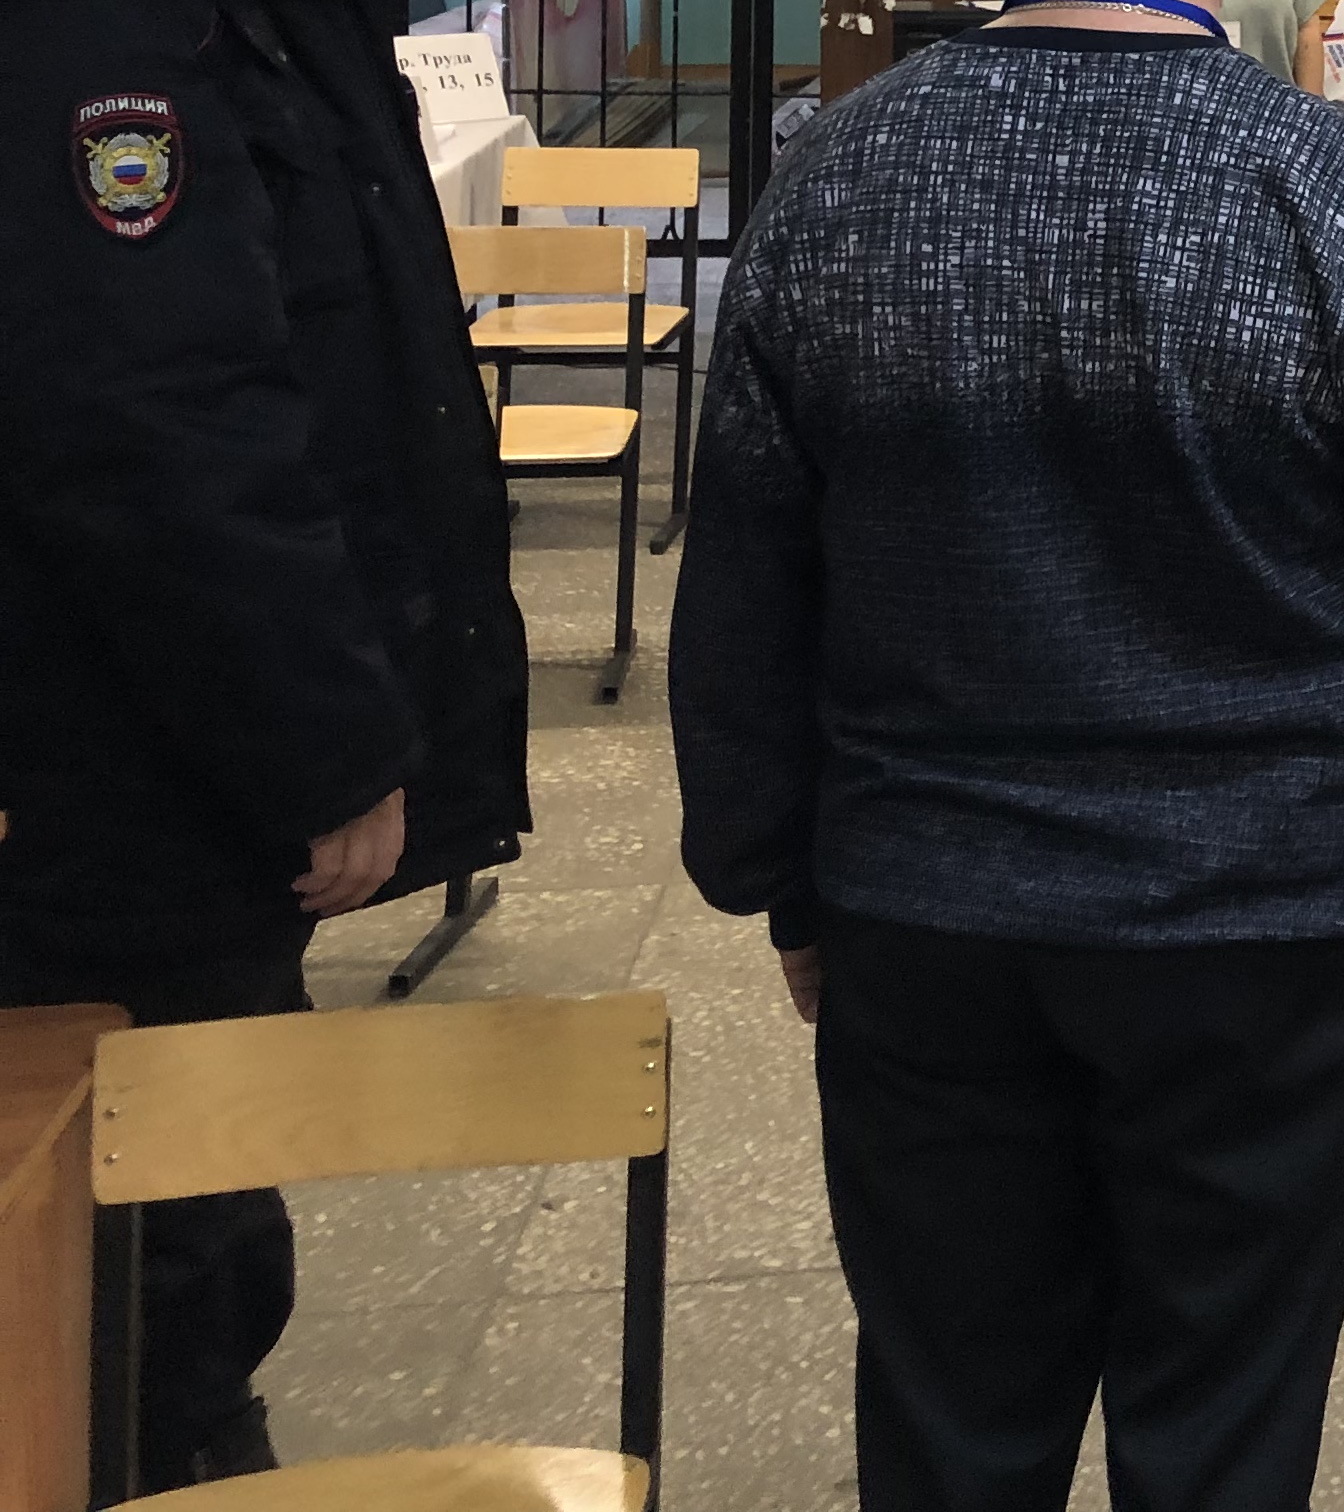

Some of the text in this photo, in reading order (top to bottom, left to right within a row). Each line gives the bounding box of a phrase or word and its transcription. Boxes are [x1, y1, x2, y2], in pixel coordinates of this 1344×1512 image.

[418, 53, 472, 69] Труда
[475, 73, 494, 87] 15
[80, 97, 168, 122] ПОЛИЦИЯ
[115, 216, 157, 236] МВД
